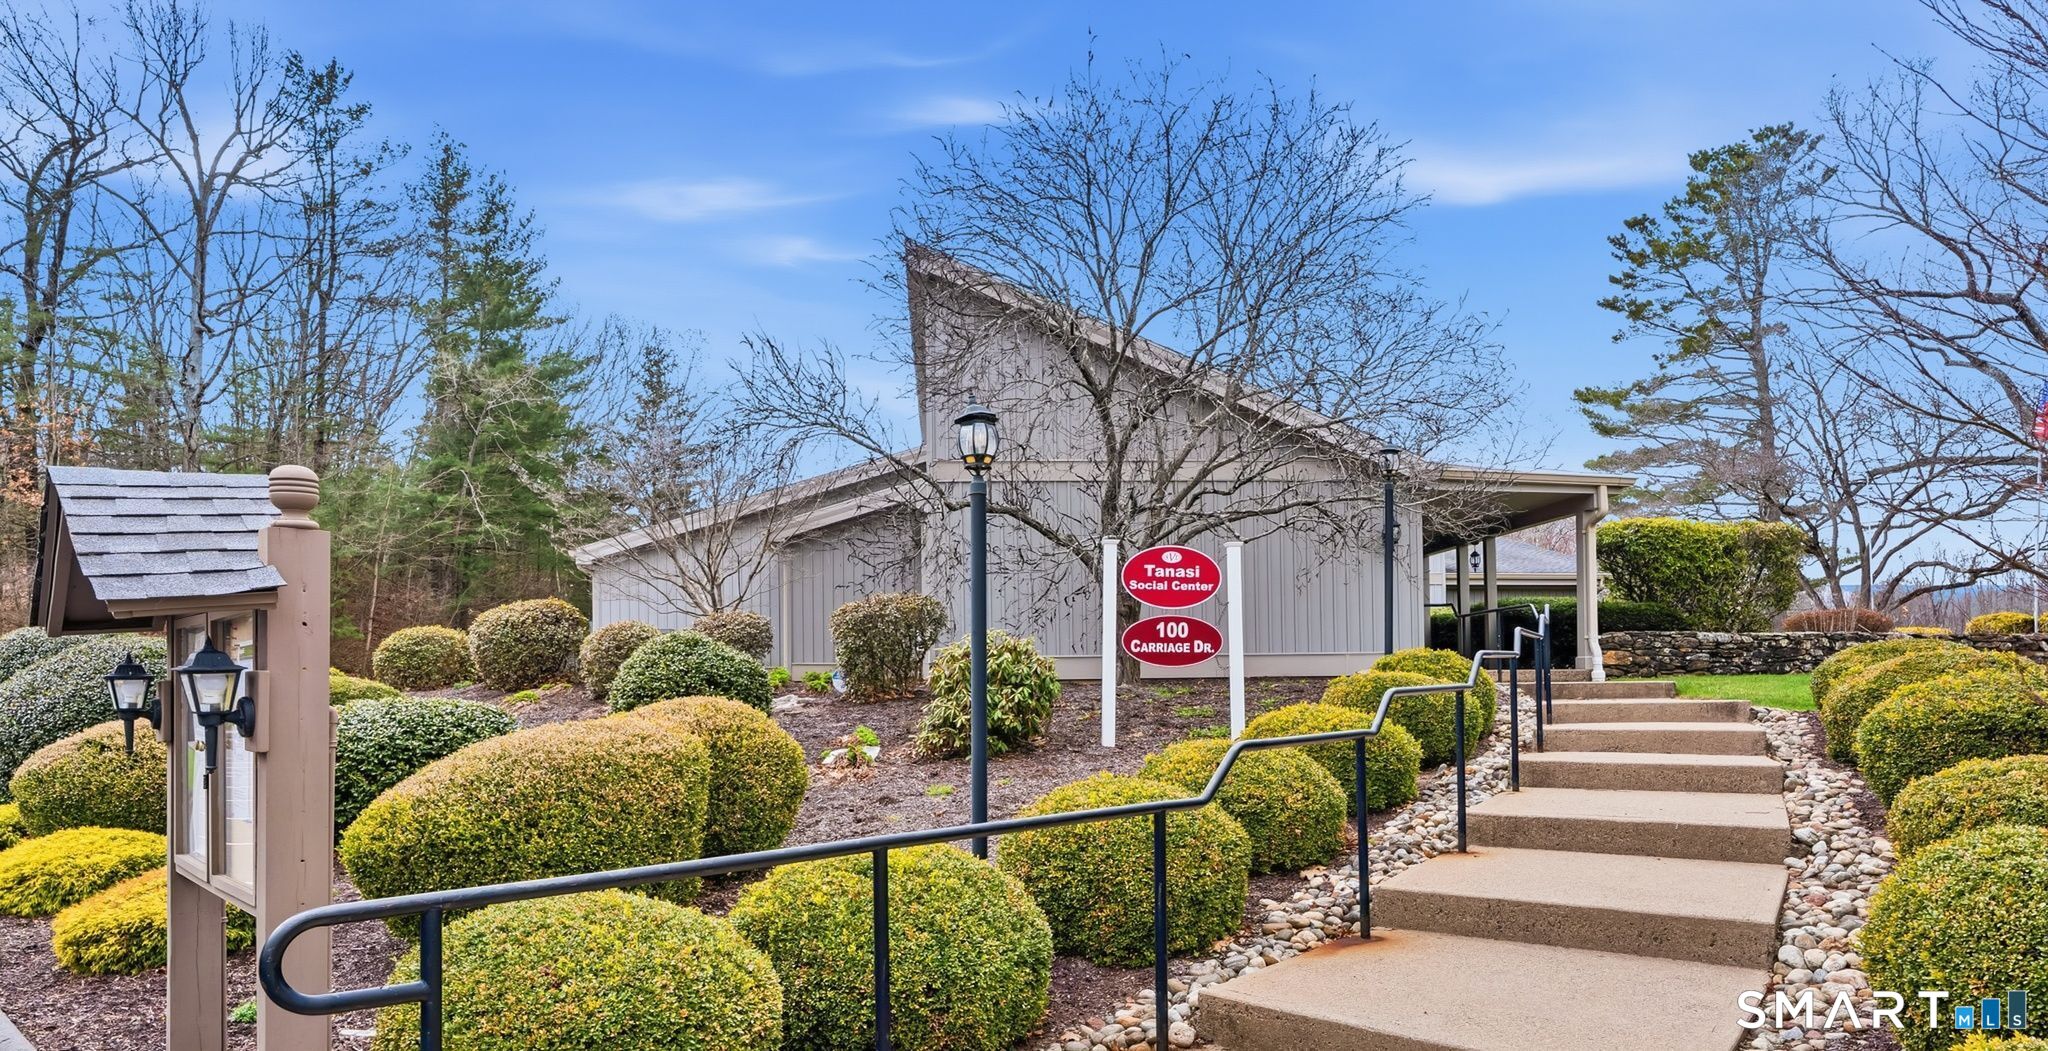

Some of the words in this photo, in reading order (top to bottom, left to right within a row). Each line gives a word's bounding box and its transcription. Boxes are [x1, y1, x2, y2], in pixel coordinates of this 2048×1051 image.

[1144, 564, 1200, 578] Tanasi
[1129, 580, 1168, 590] Social
[1171, 581, 1214, 591] Center
[1156, 622, 1189, 638] 100
[1130, 639, 1190, 653] CARRIAGE
[1194, 640, 1215, 653] DR.
